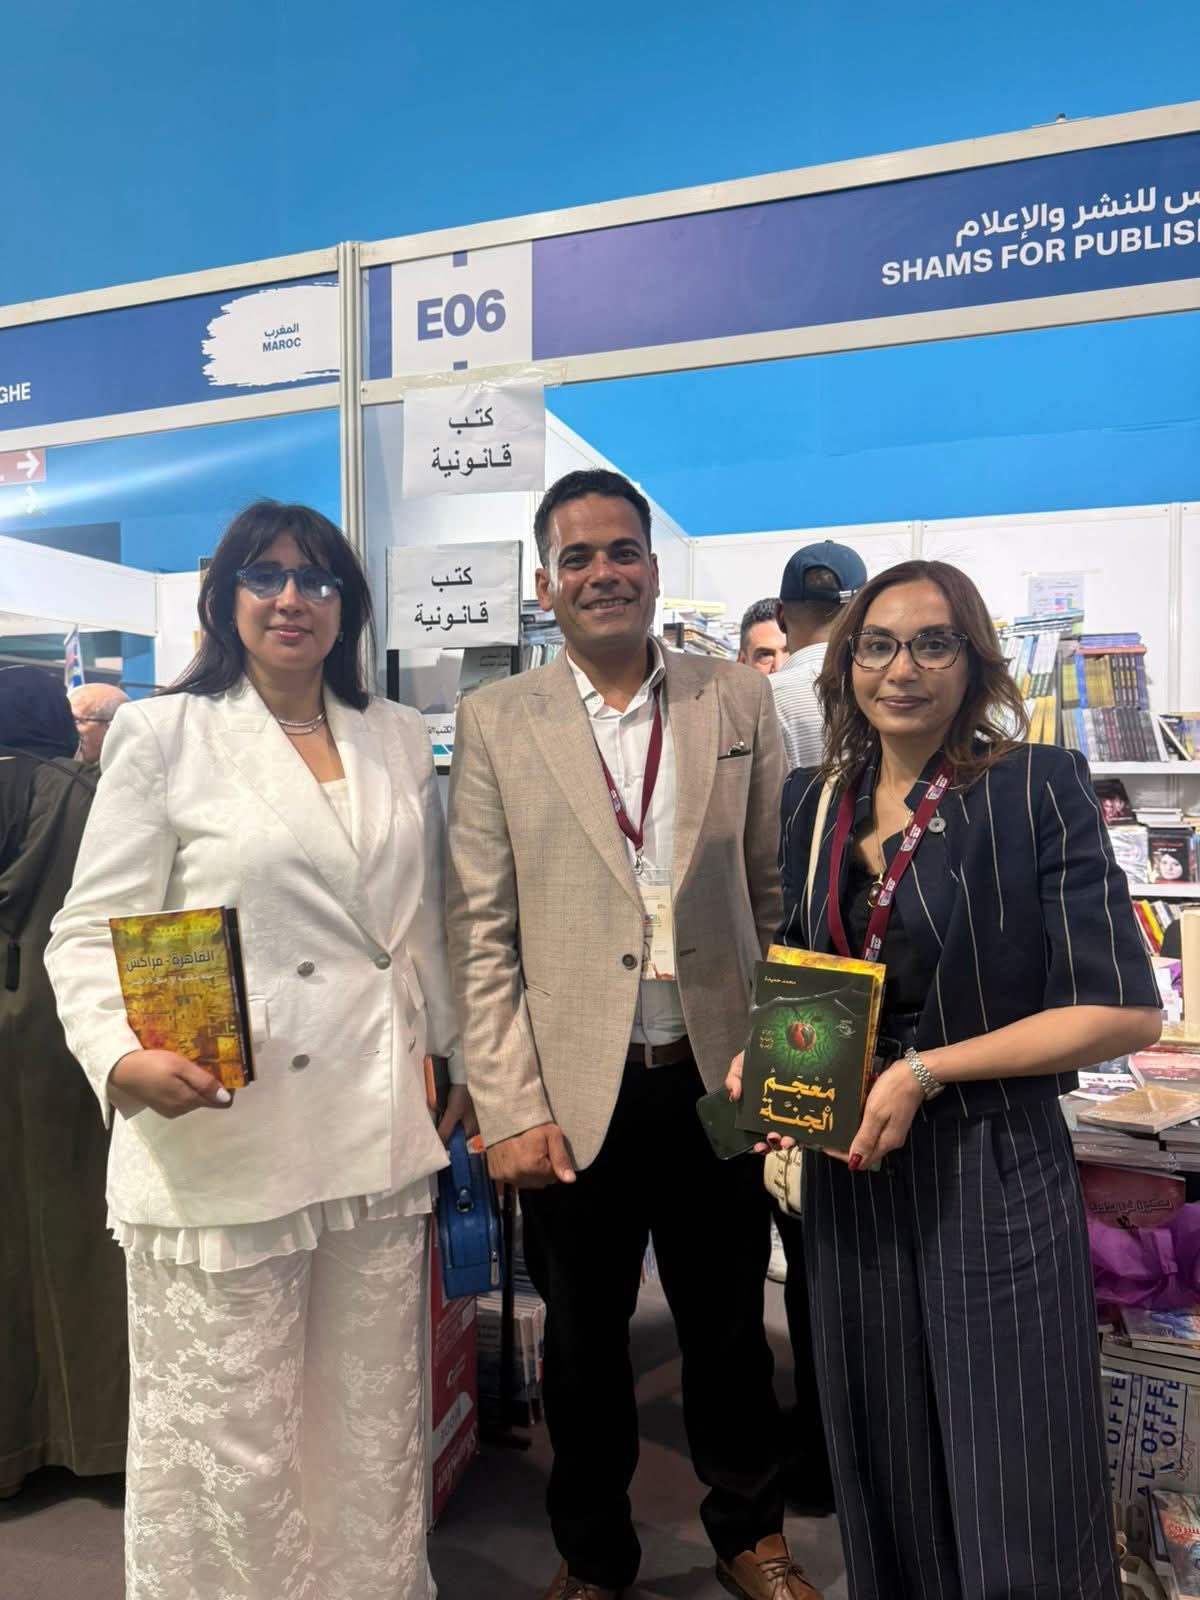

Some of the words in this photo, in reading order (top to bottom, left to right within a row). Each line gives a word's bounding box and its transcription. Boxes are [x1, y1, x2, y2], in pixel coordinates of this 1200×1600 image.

[1072, 186, 1156, 229] للنشر
[955, 203, 1065, 247] والإعلام
[881, 249, 993, 285] SHAMS
[1001, 238, 1066, 269] FOR
[417, 289, 506, 341] E06
[262, 337, 301, 352] MAROC
[264, 323, 300, 339] المغرب
[448, 407, 494, 435] كتب
[431, 443, 512, 477] قانونية
[431, 567, 473, 592] كتب
[414, 601, 489, 631] قانونية
[172, 950, 214, 967] القاهرة
